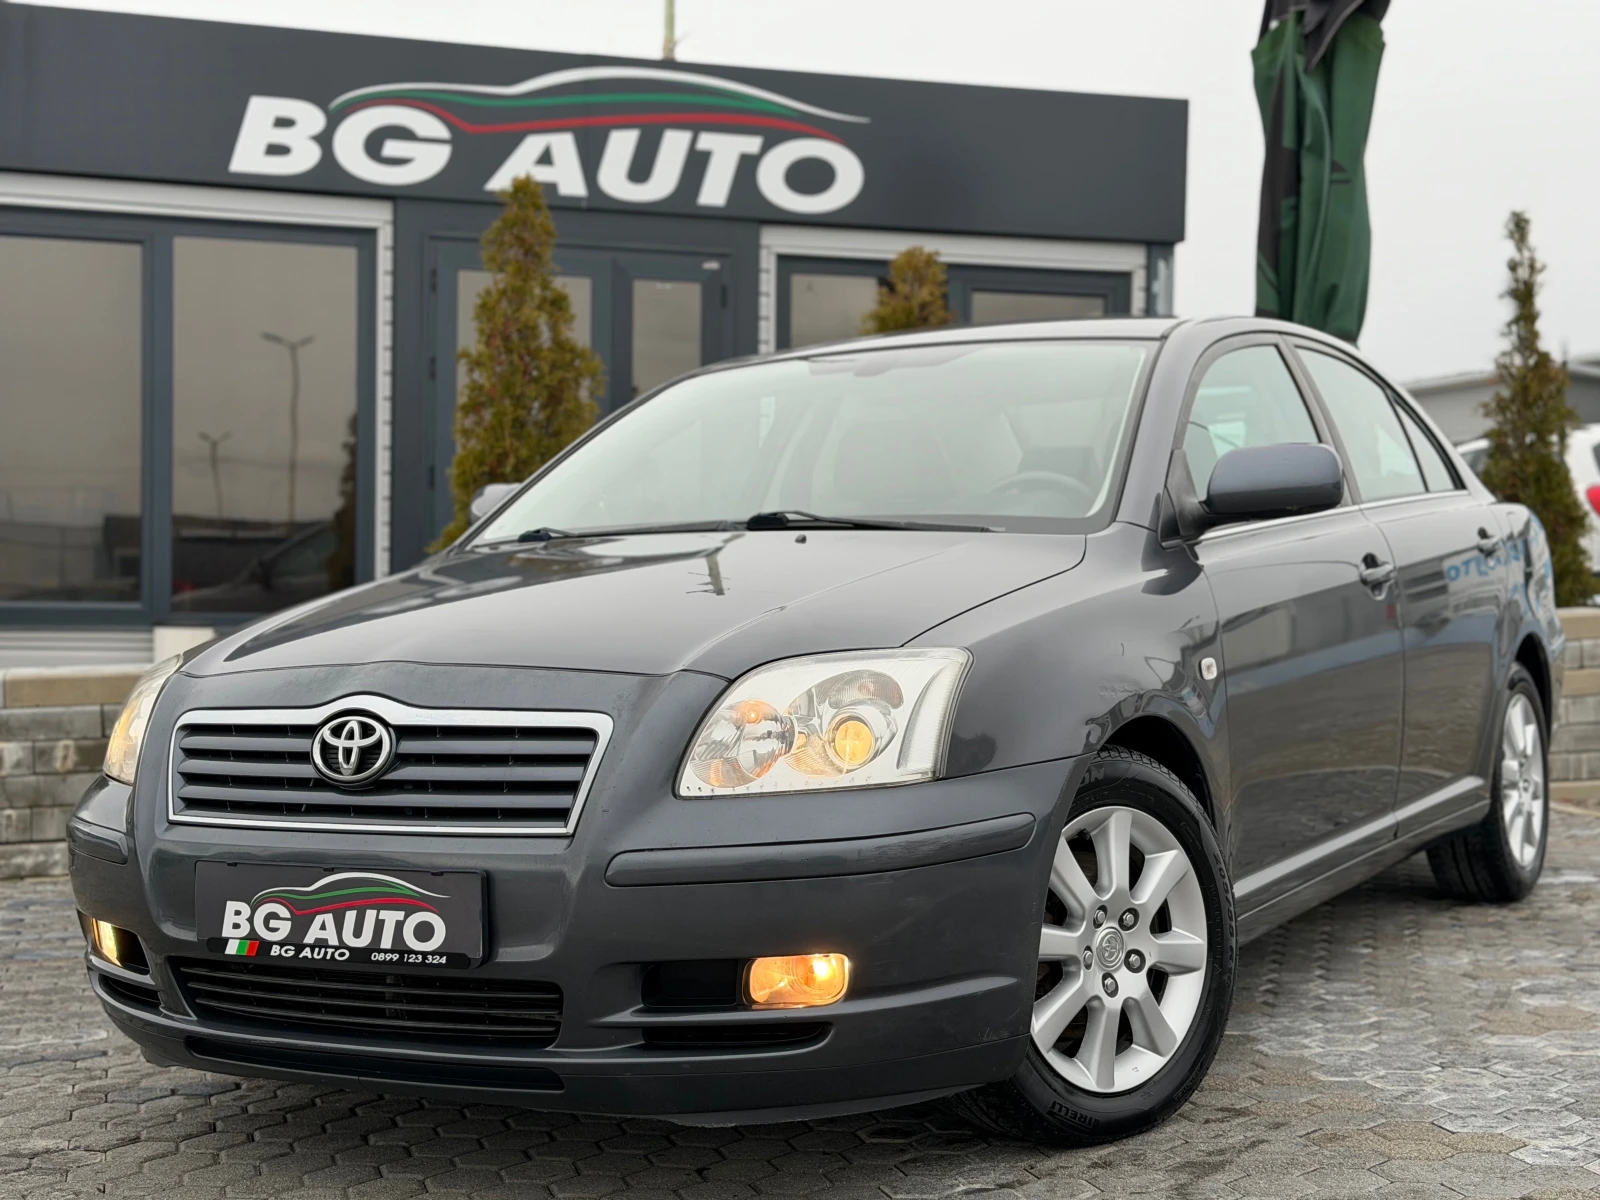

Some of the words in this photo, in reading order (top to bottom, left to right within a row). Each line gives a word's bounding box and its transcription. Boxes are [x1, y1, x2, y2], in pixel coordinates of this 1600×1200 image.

[229, 96, 452, 186] BG
[484, 128, 865, 214] AUTO
[221, 900, 292, 941] BG
[303, 909, 446, 951] AUTO
[270, 945, 295, 958] BG
[300, 947, 350, 961] AUTO
[371, 952, 399, 962] 0899
[403, 954, 422, 964] 123
[425, 955, 447, 965] 324
